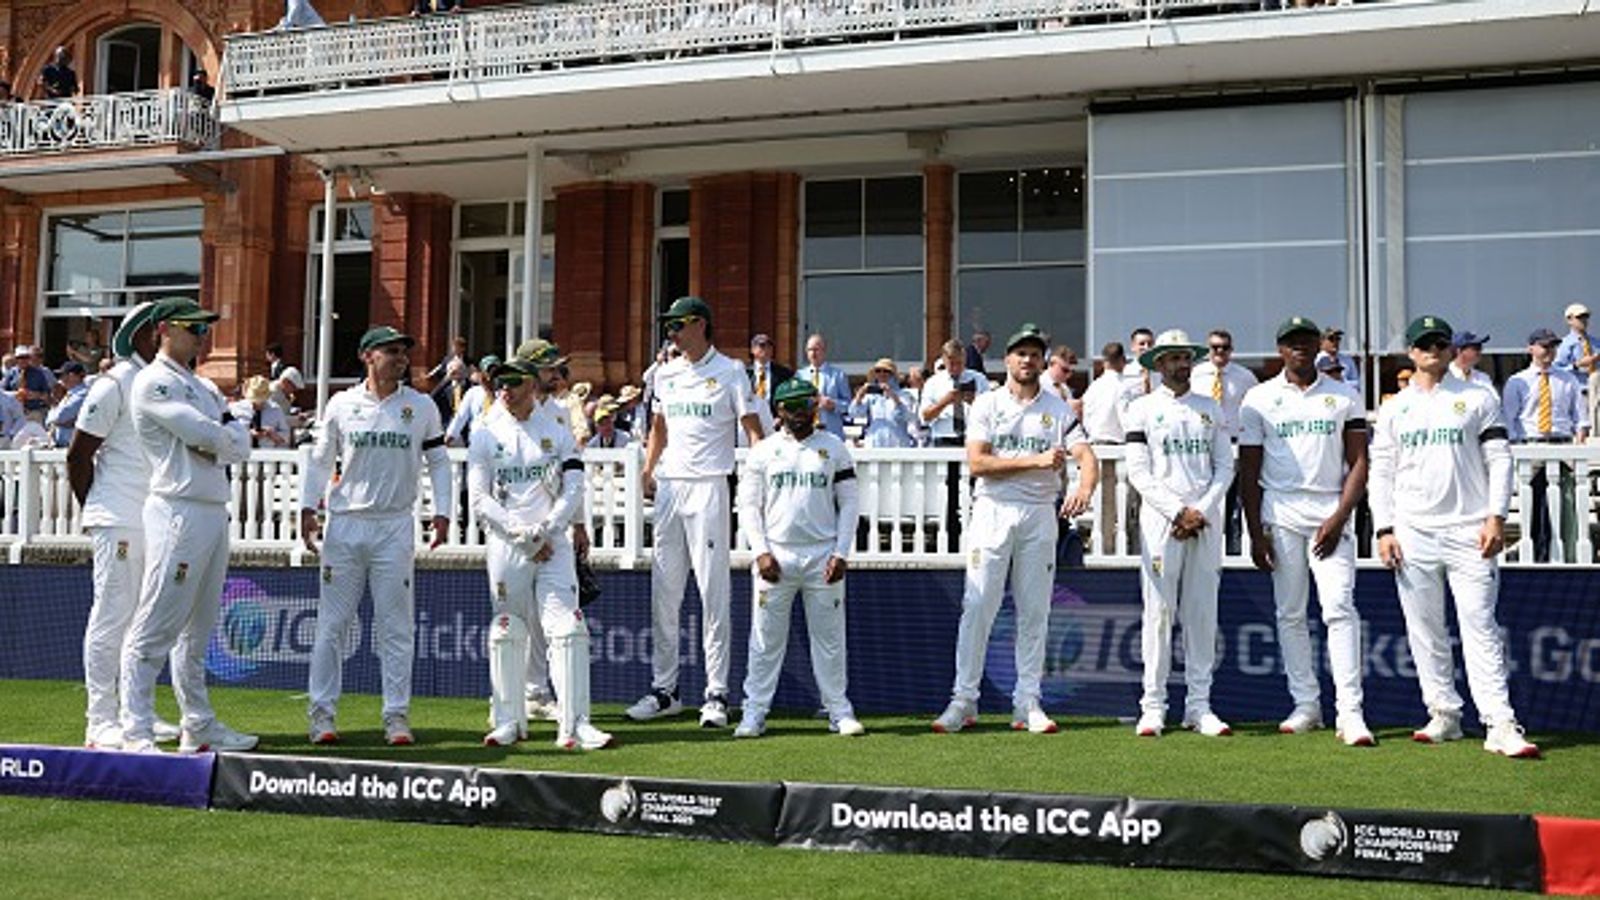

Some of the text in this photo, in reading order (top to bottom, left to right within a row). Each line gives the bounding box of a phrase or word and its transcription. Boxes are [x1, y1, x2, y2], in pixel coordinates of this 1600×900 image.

[1, 757, 44, 778] RLD
[250, 770, 497, 808] Download the ICC App
[831, 802, 1162, 843] Download the ICC App
[1354, 824, 1460, 842] ICC WORLD TEST
[1354, 836, 1454, 853] CHAMPIONSHIP
[1354, 848, 1393, 861] FINAL
